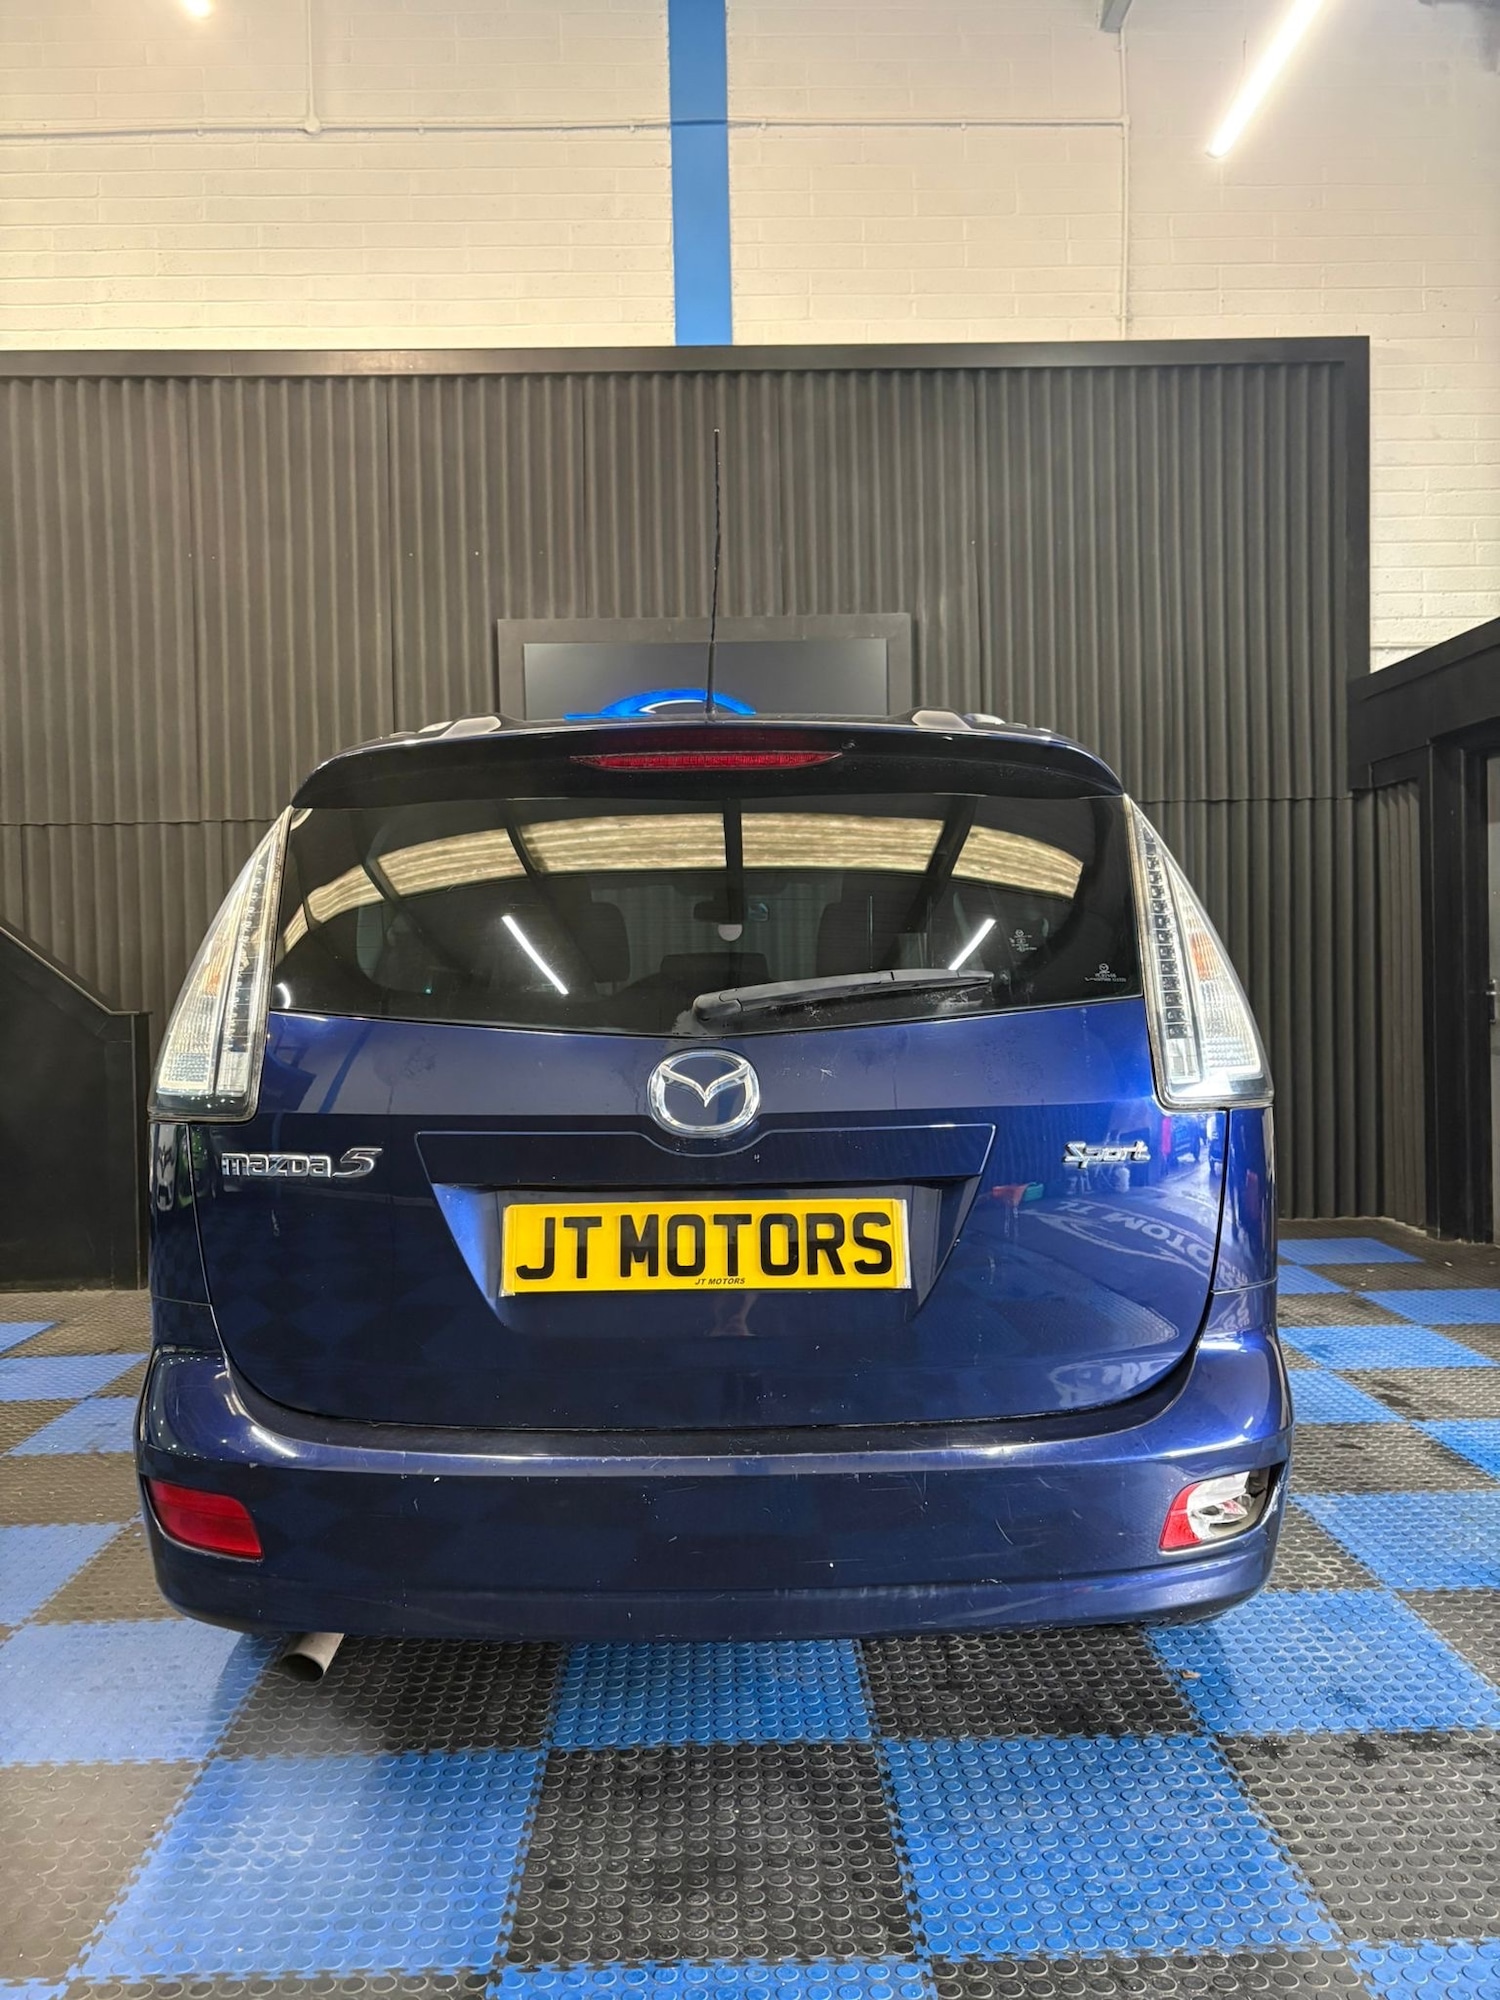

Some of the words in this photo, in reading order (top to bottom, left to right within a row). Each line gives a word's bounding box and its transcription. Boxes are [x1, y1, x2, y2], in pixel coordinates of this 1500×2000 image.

[332, 1147, 383, 1178] 5
[1062, 1140, 1151, 1169] Sport
[516, 1215, 602, 1280] JT
[619, 1211, 893, 1278] MOTORS
[695, 1278, 706, 1286] JT
[708, 1277, 746, 1286] MOTORS
